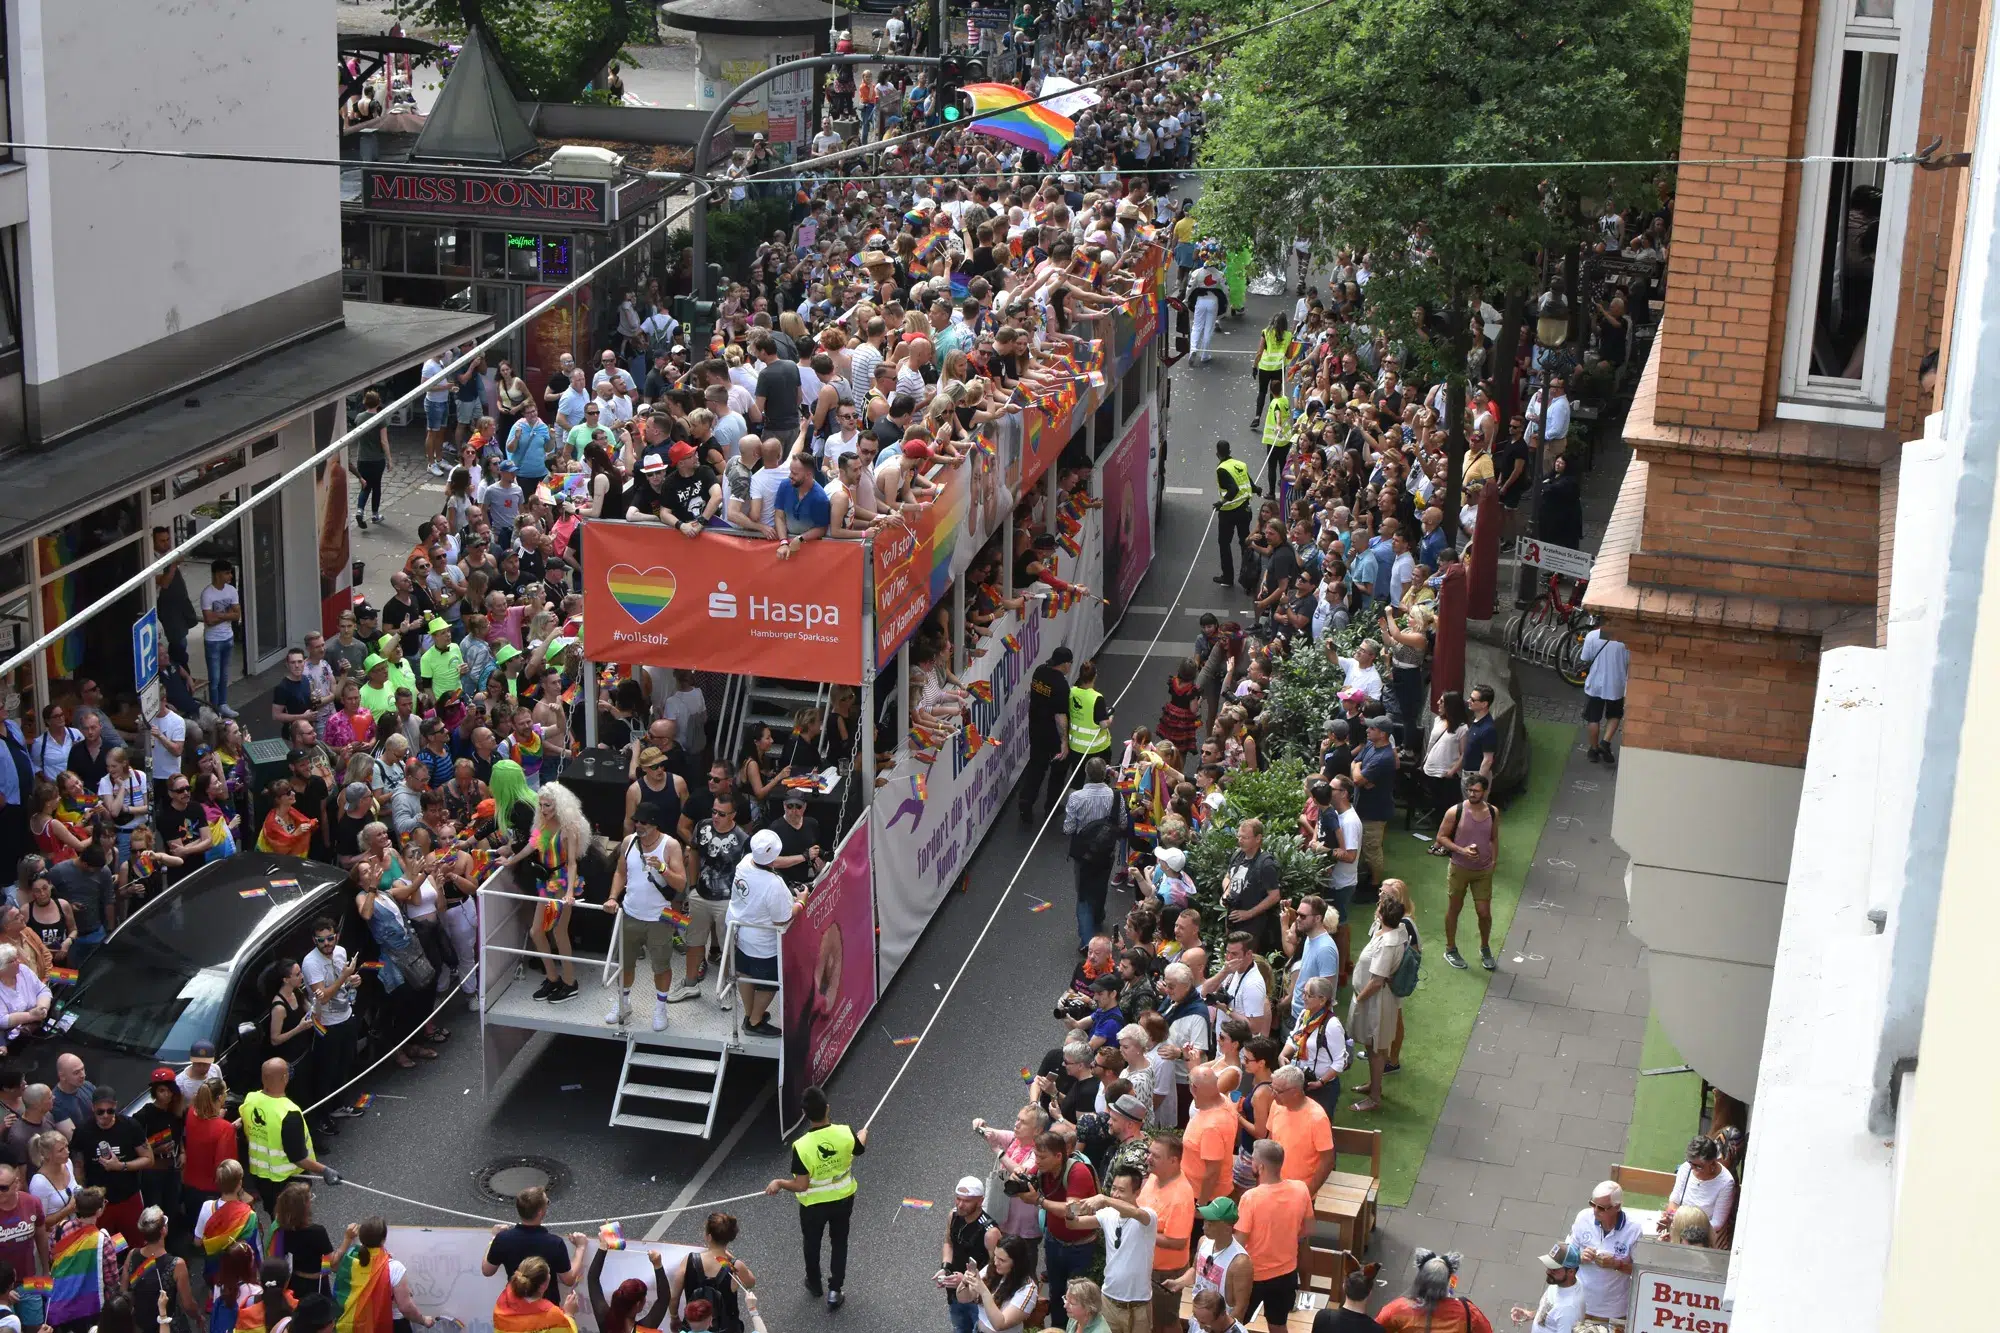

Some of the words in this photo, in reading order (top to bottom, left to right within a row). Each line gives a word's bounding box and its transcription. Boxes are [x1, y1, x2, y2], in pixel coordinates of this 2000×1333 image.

[371, 174, 456, 204] MISS
[463, 176, 599, 212] DÖNER
[880, 541, 897, 569] Voll
[749, 595, 839, 629] Haspa
[613, 630, 669, 646] #vollstolz
[750, 629, 797, 641] Hamburger
[798, 631, 839, 643] Sparkasse
[881, 620, 896, 650] Voll
[140, 623, 152, 678] P
[917, 811, 949, 879] fordert
[951, 796, 963, 832] die
[42, 928, 59, 938] EAT
